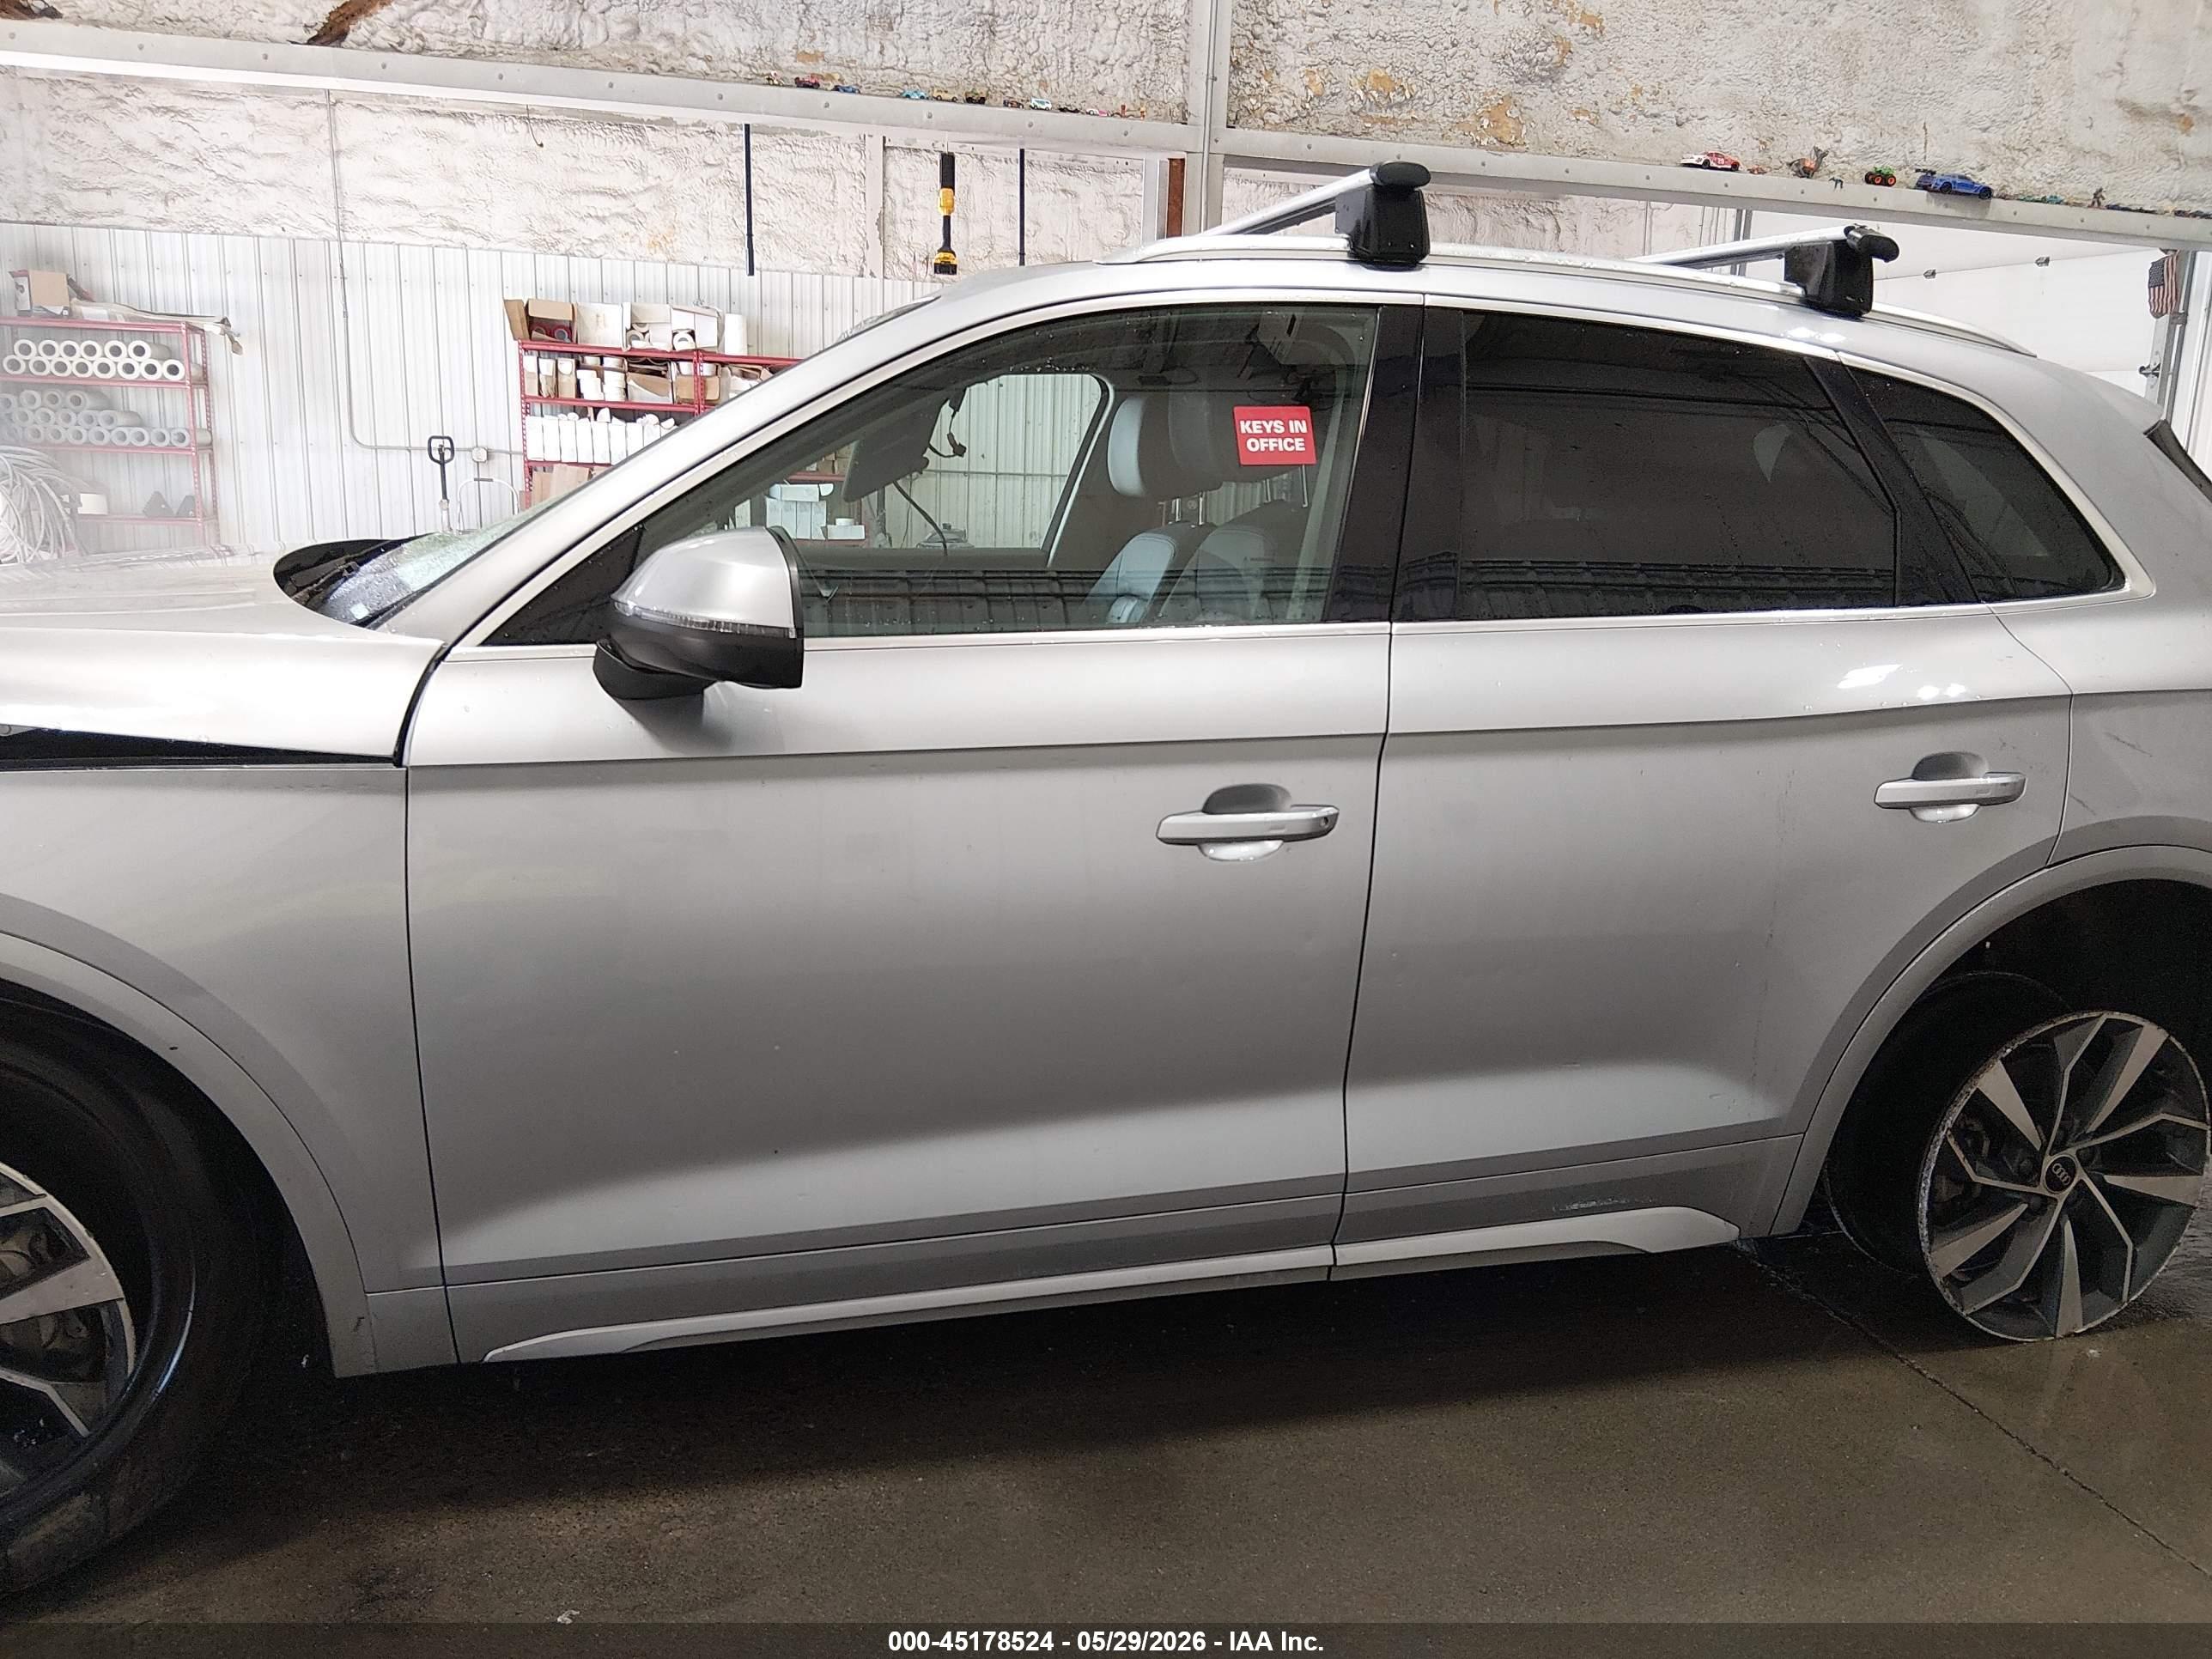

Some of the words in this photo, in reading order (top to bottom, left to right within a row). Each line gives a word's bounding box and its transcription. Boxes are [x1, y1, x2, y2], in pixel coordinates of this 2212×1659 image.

[1239, 420, 1285, 434] KEYS
[1289, 420, 1307, 434] IN
[1246, 437, 1306, 452] OFFICE
